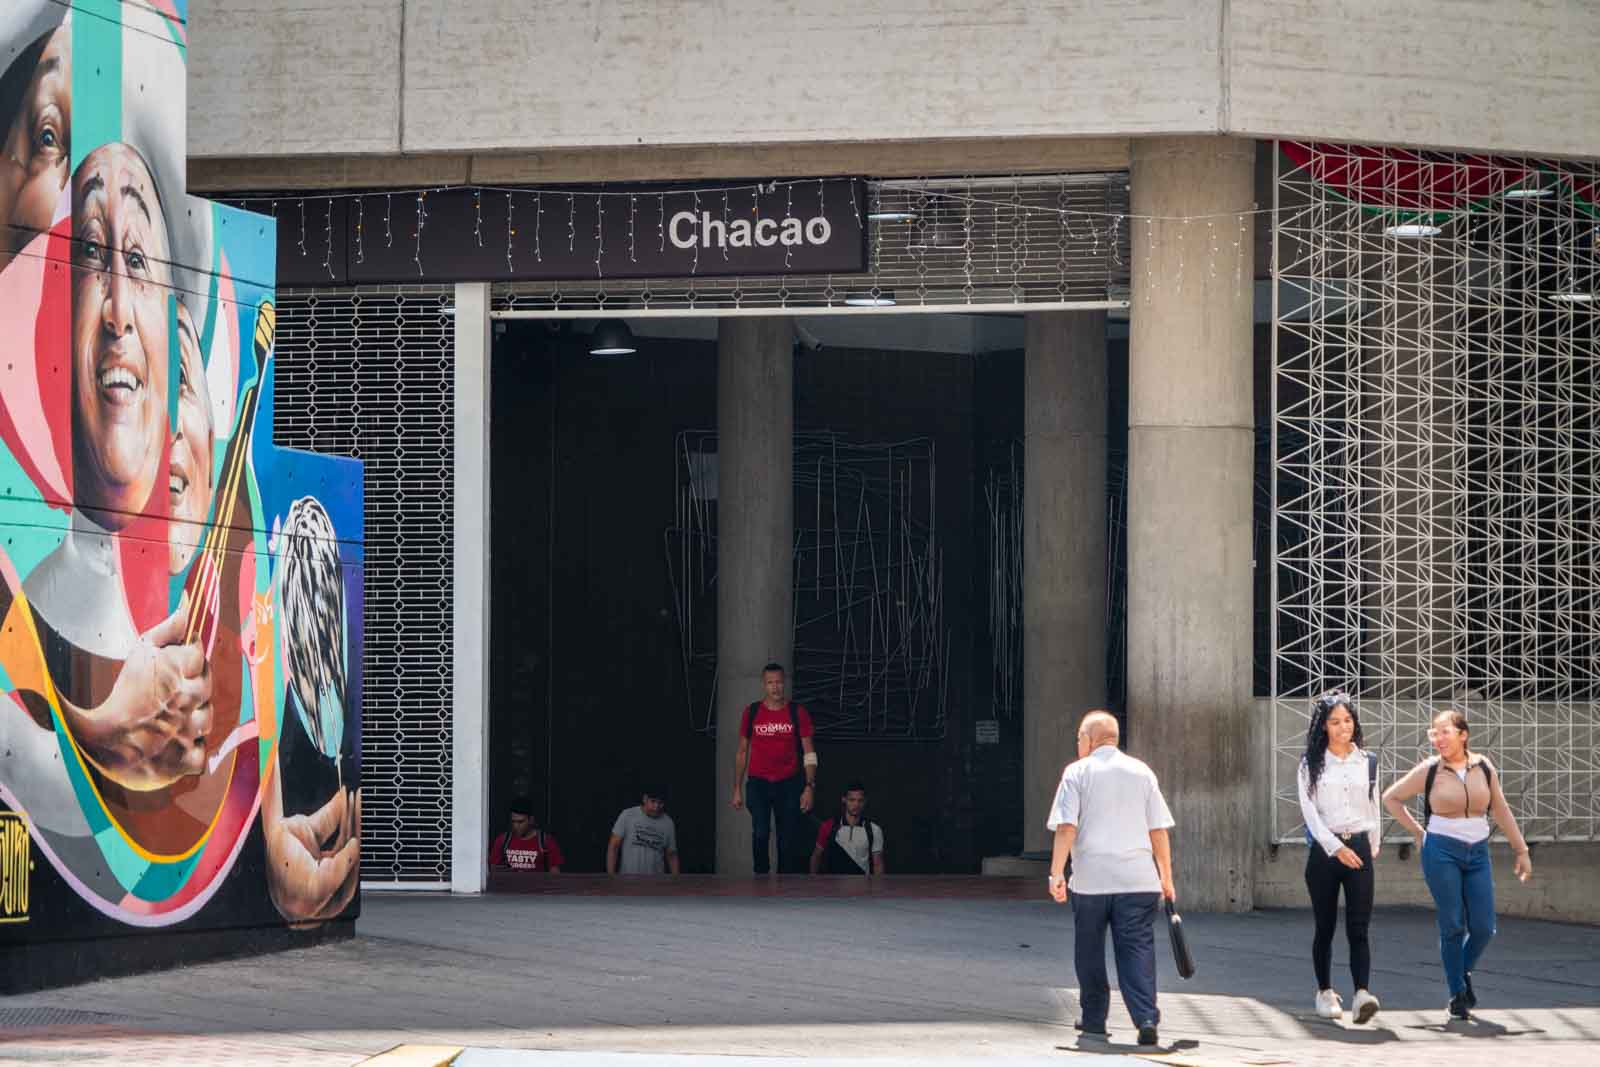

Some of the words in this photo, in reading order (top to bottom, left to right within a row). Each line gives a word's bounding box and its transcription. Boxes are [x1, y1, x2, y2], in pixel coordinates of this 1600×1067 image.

[669, 211, 832, 249] Chacao
[754, 723, 793, 733] TOMMY
[507, 855, 537, 864] TASTY
